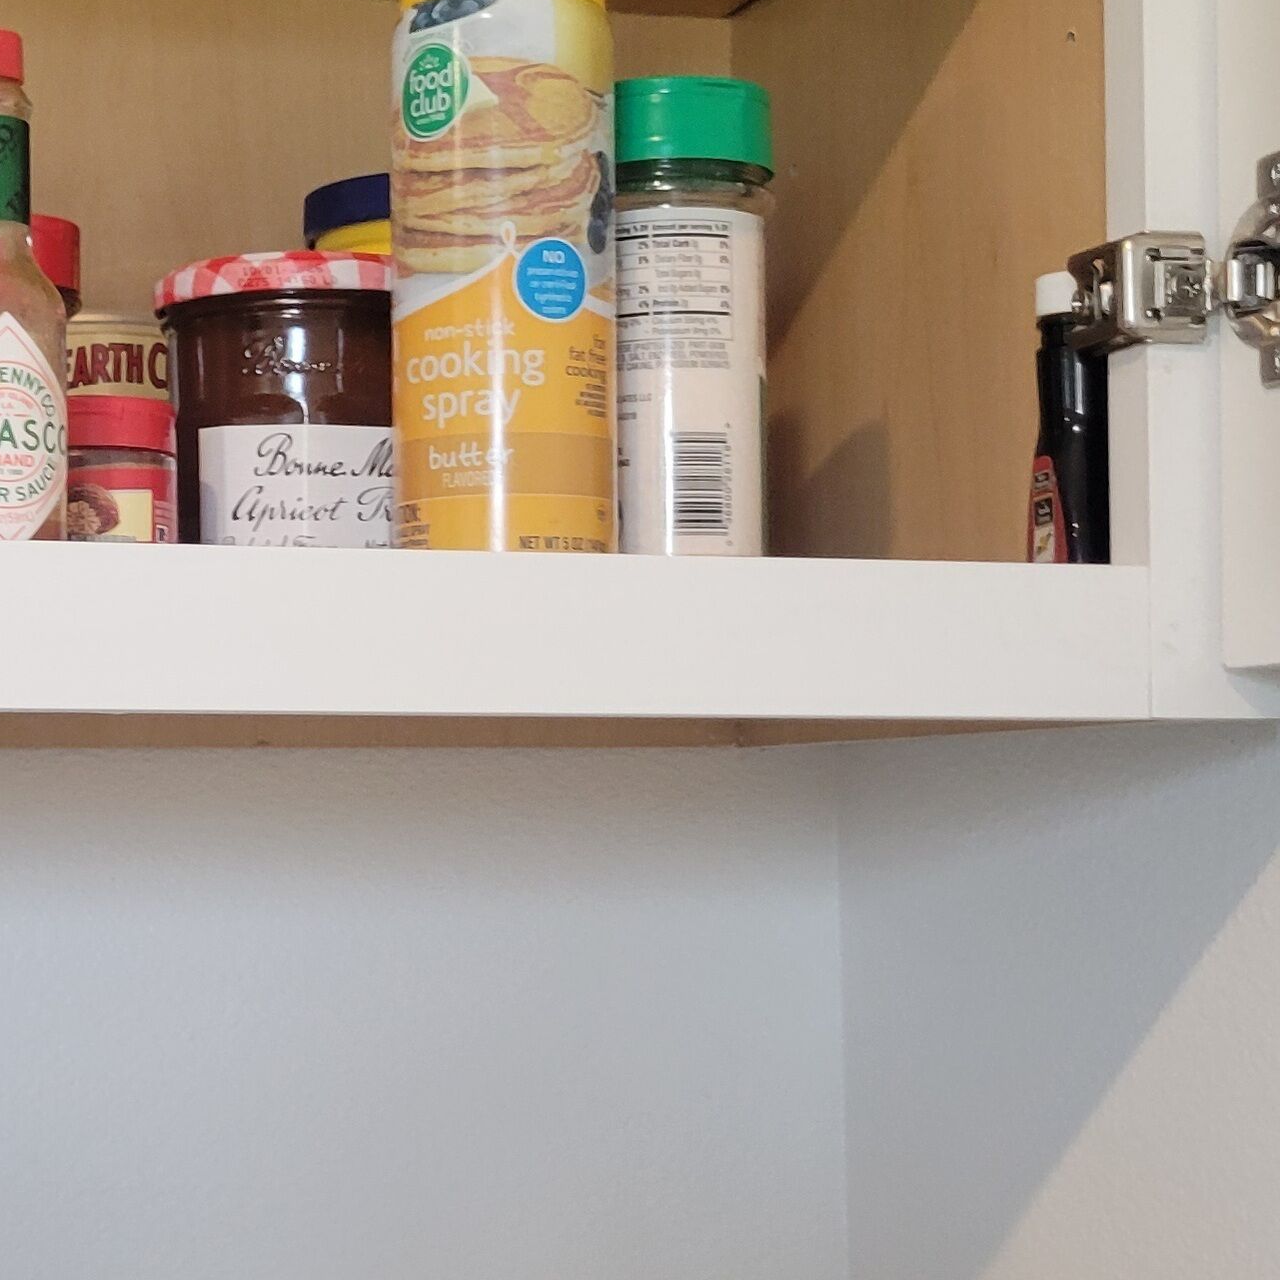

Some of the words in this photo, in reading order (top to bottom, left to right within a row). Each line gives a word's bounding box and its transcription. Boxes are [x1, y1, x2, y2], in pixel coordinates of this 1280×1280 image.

[409, 61, 455, 94] food
[410, 87, 452, 117] club
[406, 339, 546, 387] cooking
[422, 387, 521, 429] spray
[253, 432, 347, 477] Bonne
[428, 441, 516, 471] butter
[231, 485, 348, 533] Apricot
[519, 535, 540, 549] NET
[543, 536, 561, 550] WT
